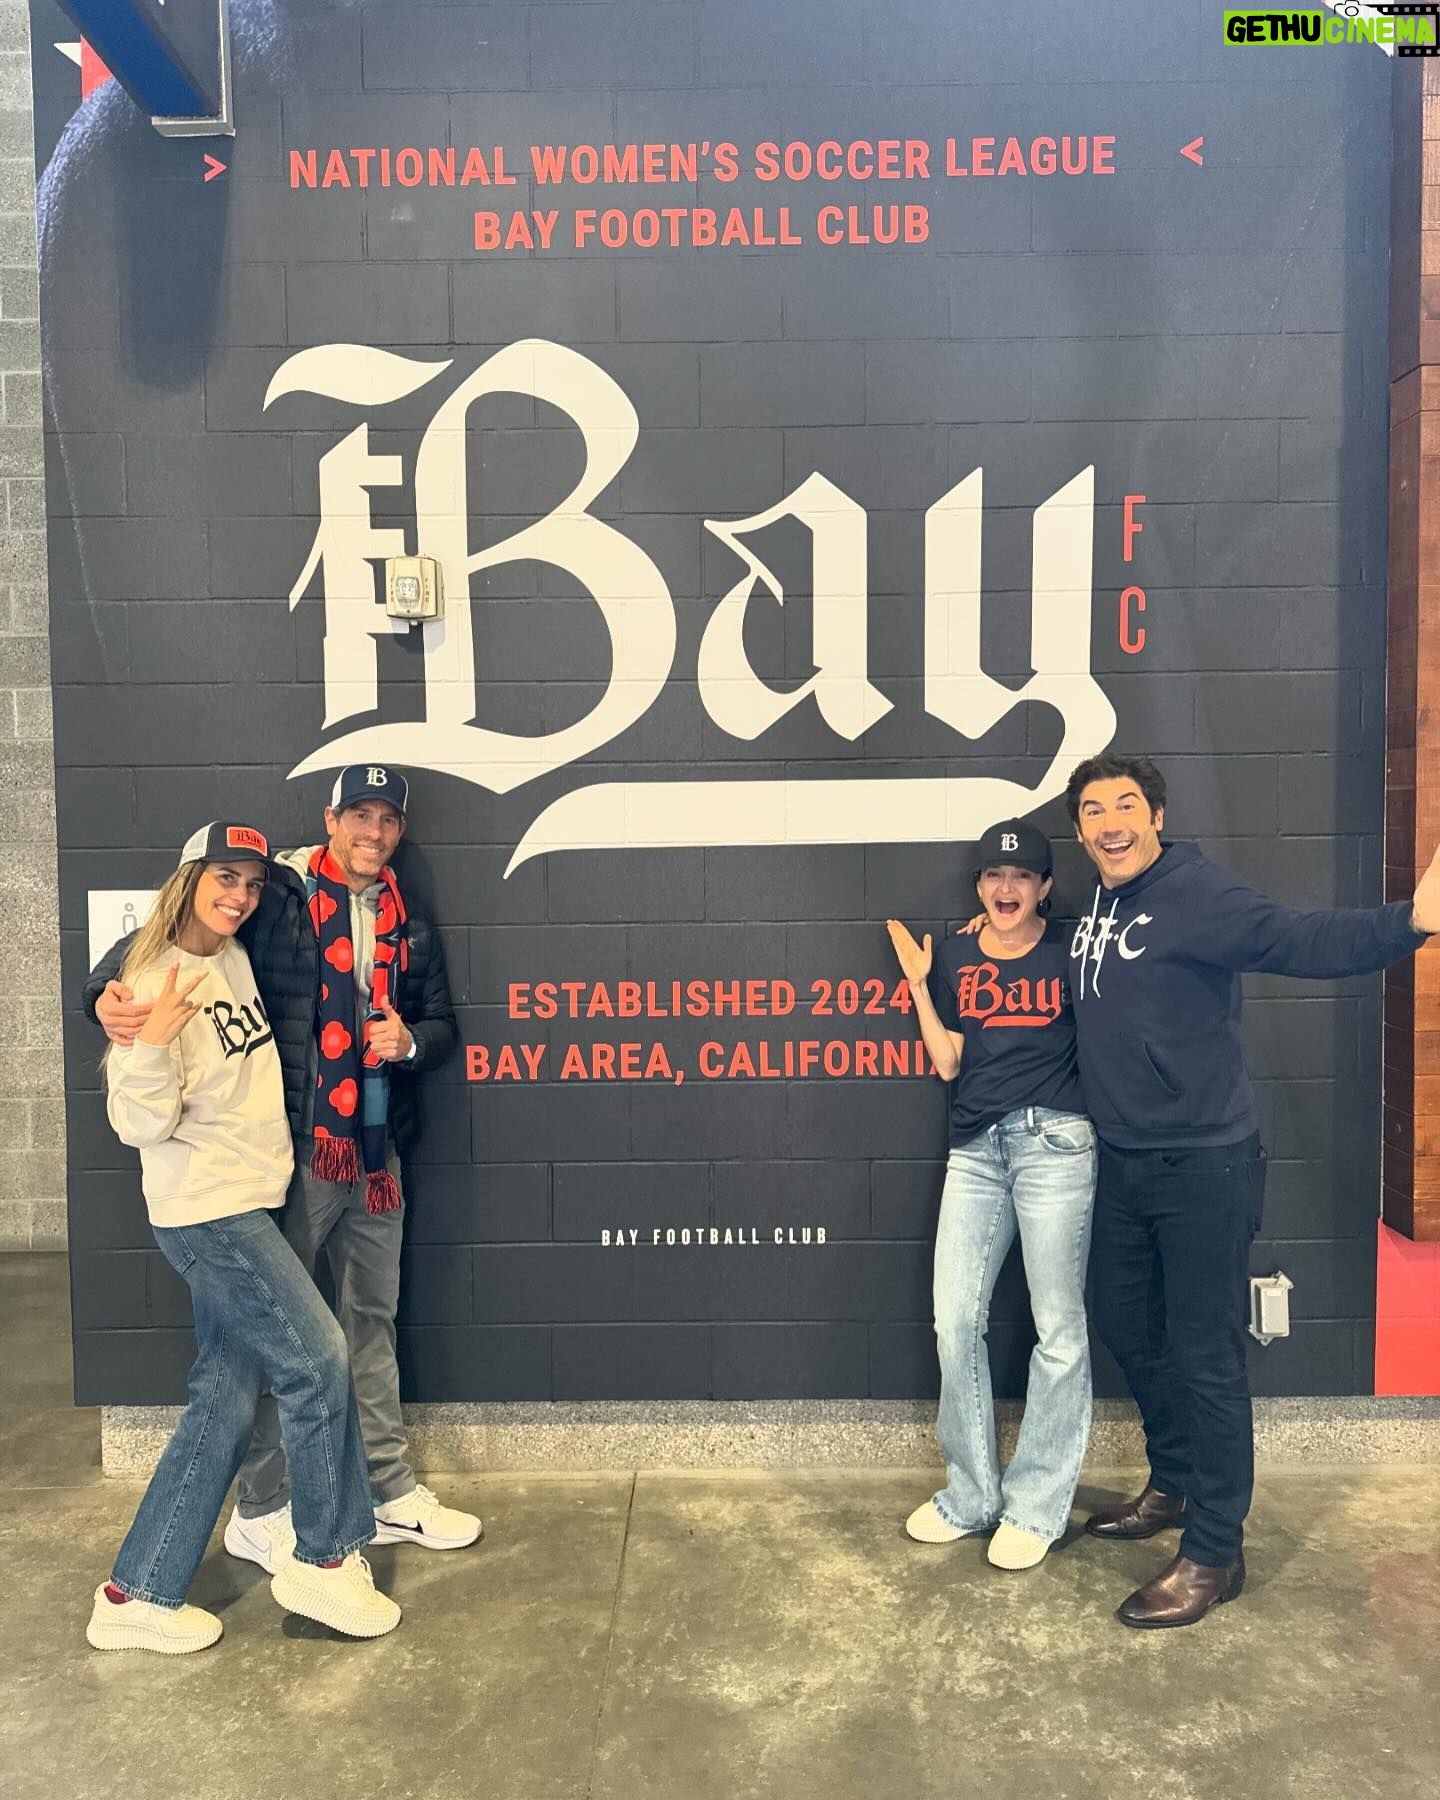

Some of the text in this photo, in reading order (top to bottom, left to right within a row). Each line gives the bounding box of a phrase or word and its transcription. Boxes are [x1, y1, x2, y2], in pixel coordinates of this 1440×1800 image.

[289, 136, 1115, 189] NATIONAL WOMEN’S SOCCER LEAGUE
[473, 204, 930, 250] BAY FOOTBALL CLUB
[263, 337, 1117, 880] Bay
[366, 767, 388, 787] B
[1000, 833, 1019, 851] B
[508, 978, 912, 1019] ESTABLISHED 2024
[957, 962, 1062, 1029] Bay
[465, 1039, 939, 1086] BAY AREA, CALIFORNI
[601, 1227, 828, 1247] BAY FOOTBALL CLUB
